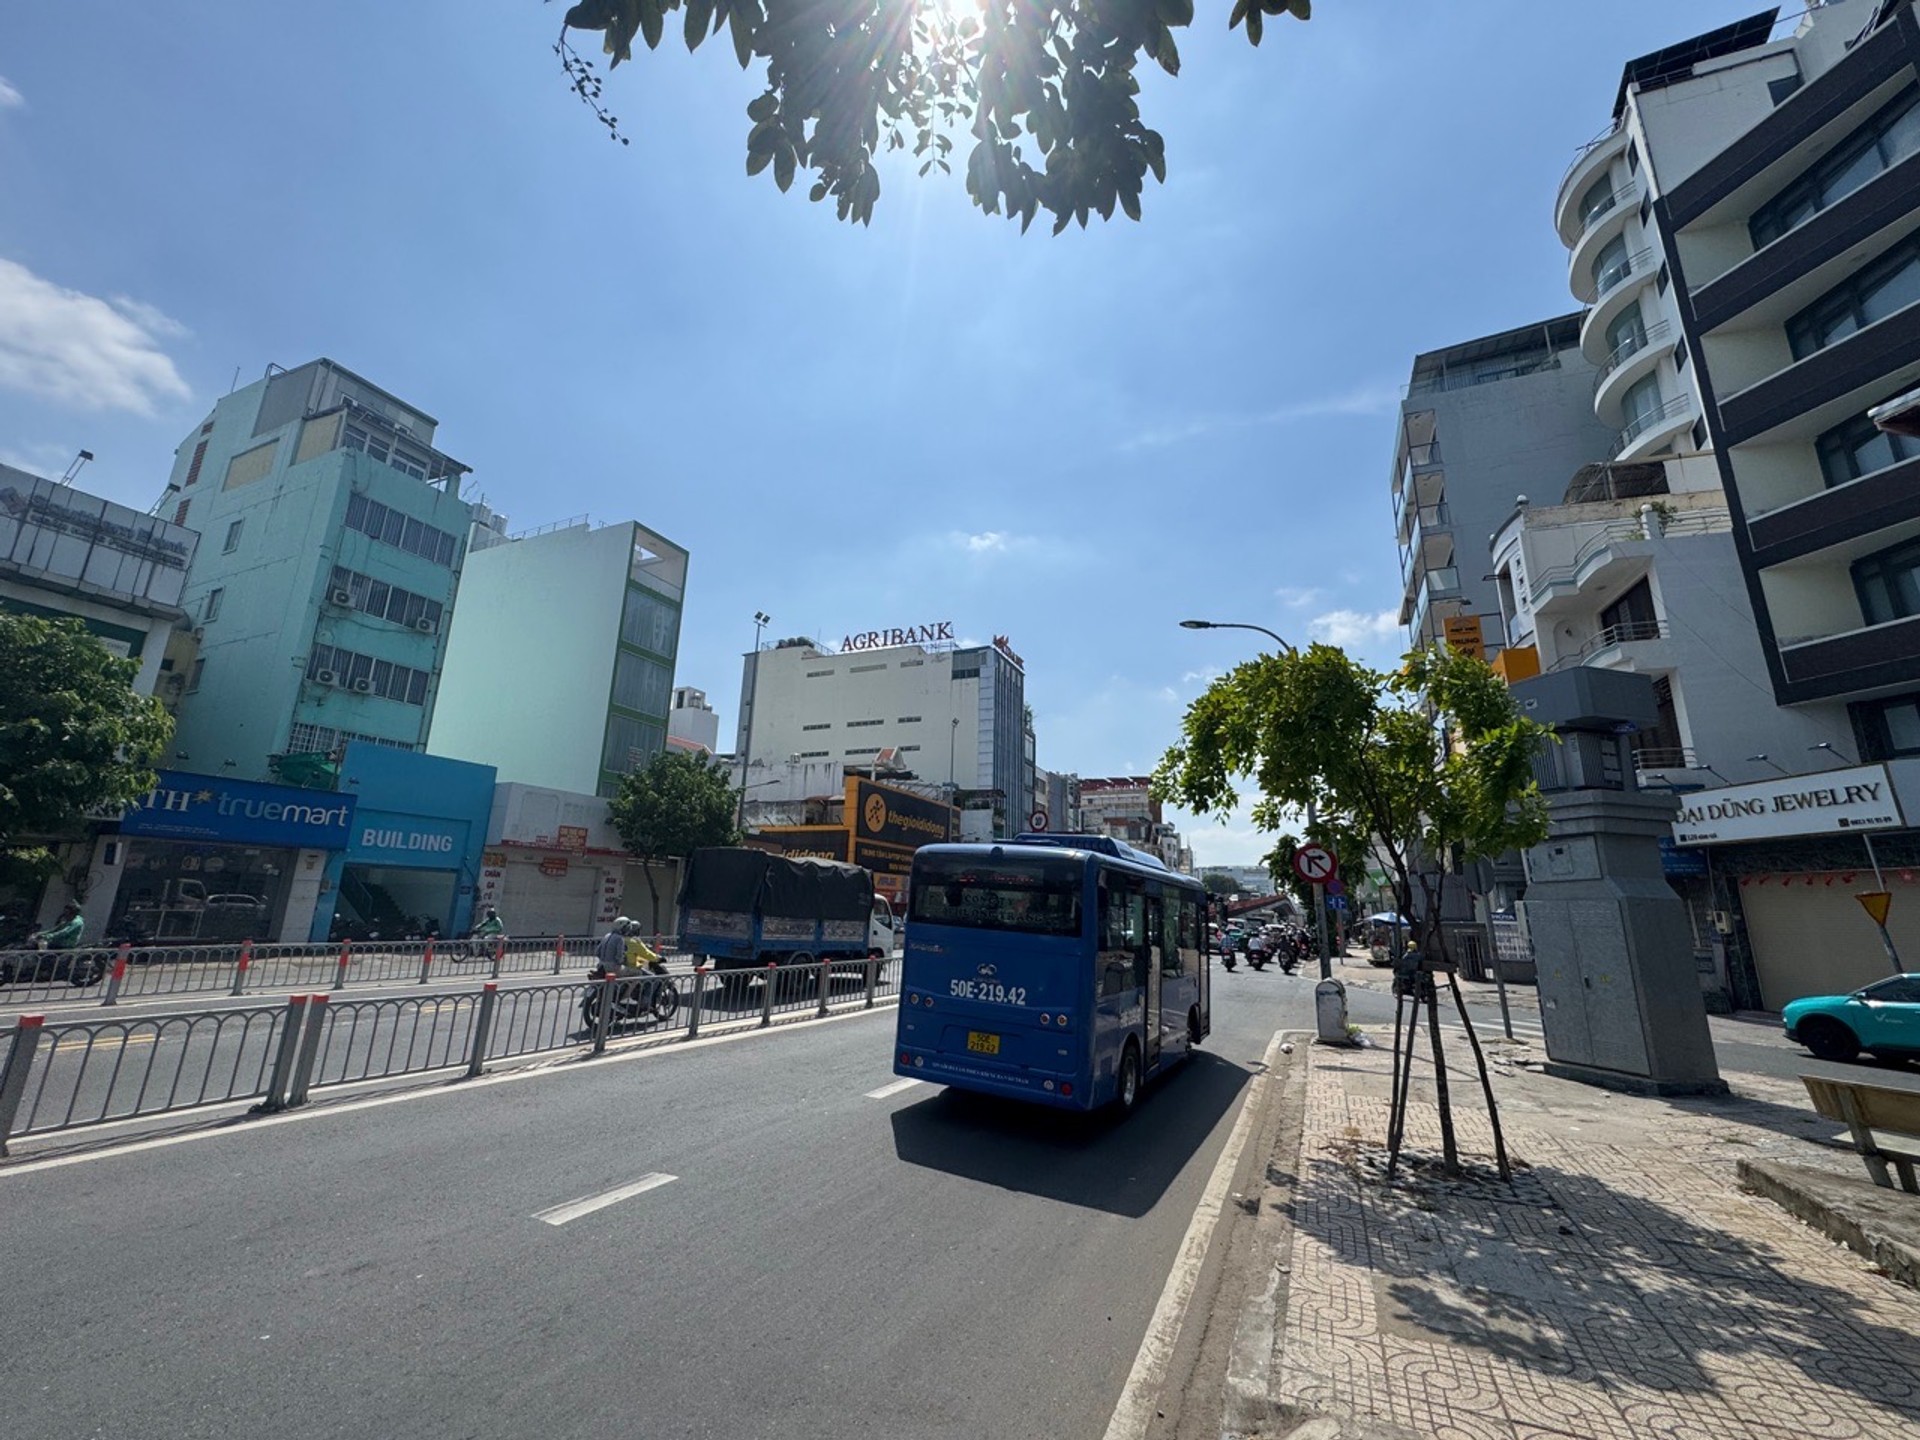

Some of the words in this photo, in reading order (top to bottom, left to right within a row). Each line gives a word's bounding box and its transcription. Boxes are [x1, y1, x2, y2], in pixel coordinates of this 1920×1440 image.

[841, 621, 953, 652] AGRIBANK
[144, 788, 193, 813] TH
[218, 792, 348, 827] truemart
[1710, 796, 1765, 820] DŨNG
[1771, 782, 1882, 814] JEWELRY
[362, 829, 453, 852] BUILDING
[783, 848, 835, 860] ididong
[950, 979, 1026, 1006] 50E-219.42
